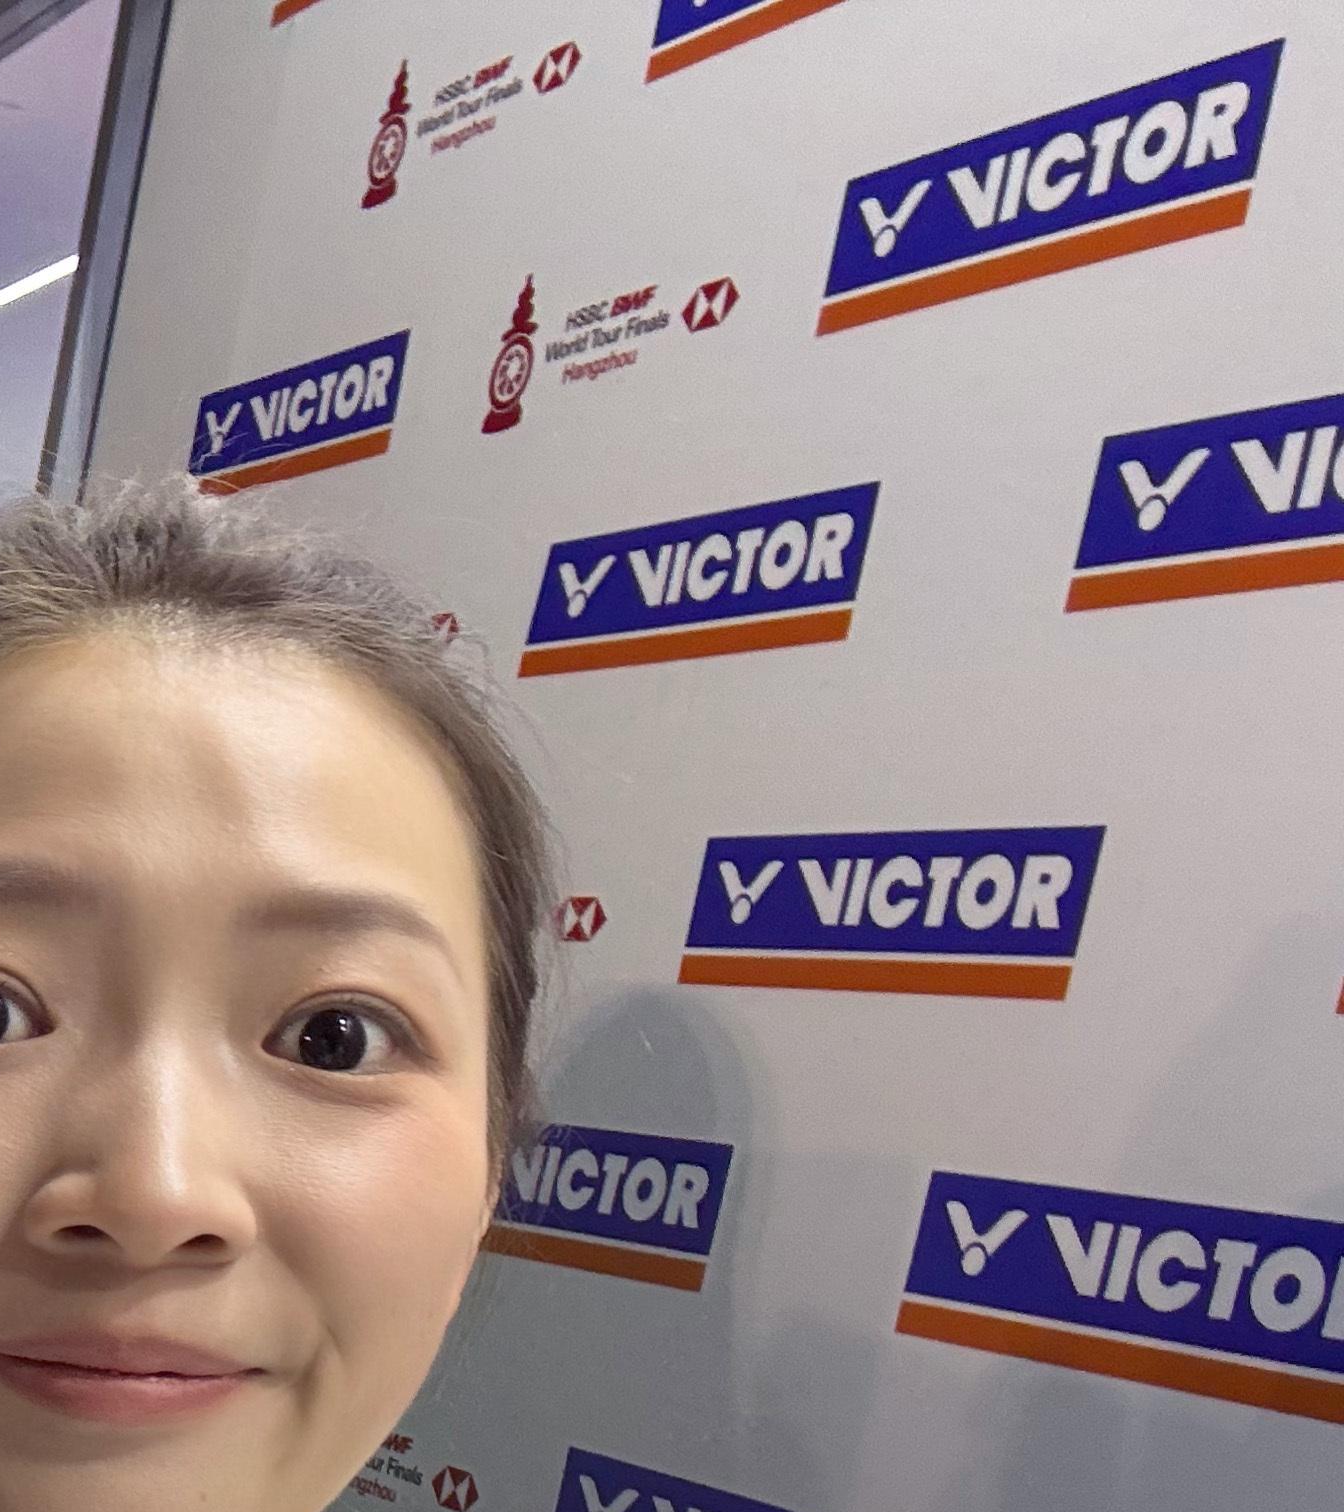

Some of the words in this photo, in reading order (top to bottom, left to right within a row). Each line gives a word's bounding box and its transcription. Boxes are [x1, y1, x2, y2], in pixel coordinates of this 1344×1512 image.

[946, 80, 1251, 230] VICTOR
[249, 355, 394, 441] VICTOR
[1230, 425, 1344, 513] VI
[627, 512, 854, 608] VICTOR
[798, 854, 1073, 930] VICTOR
